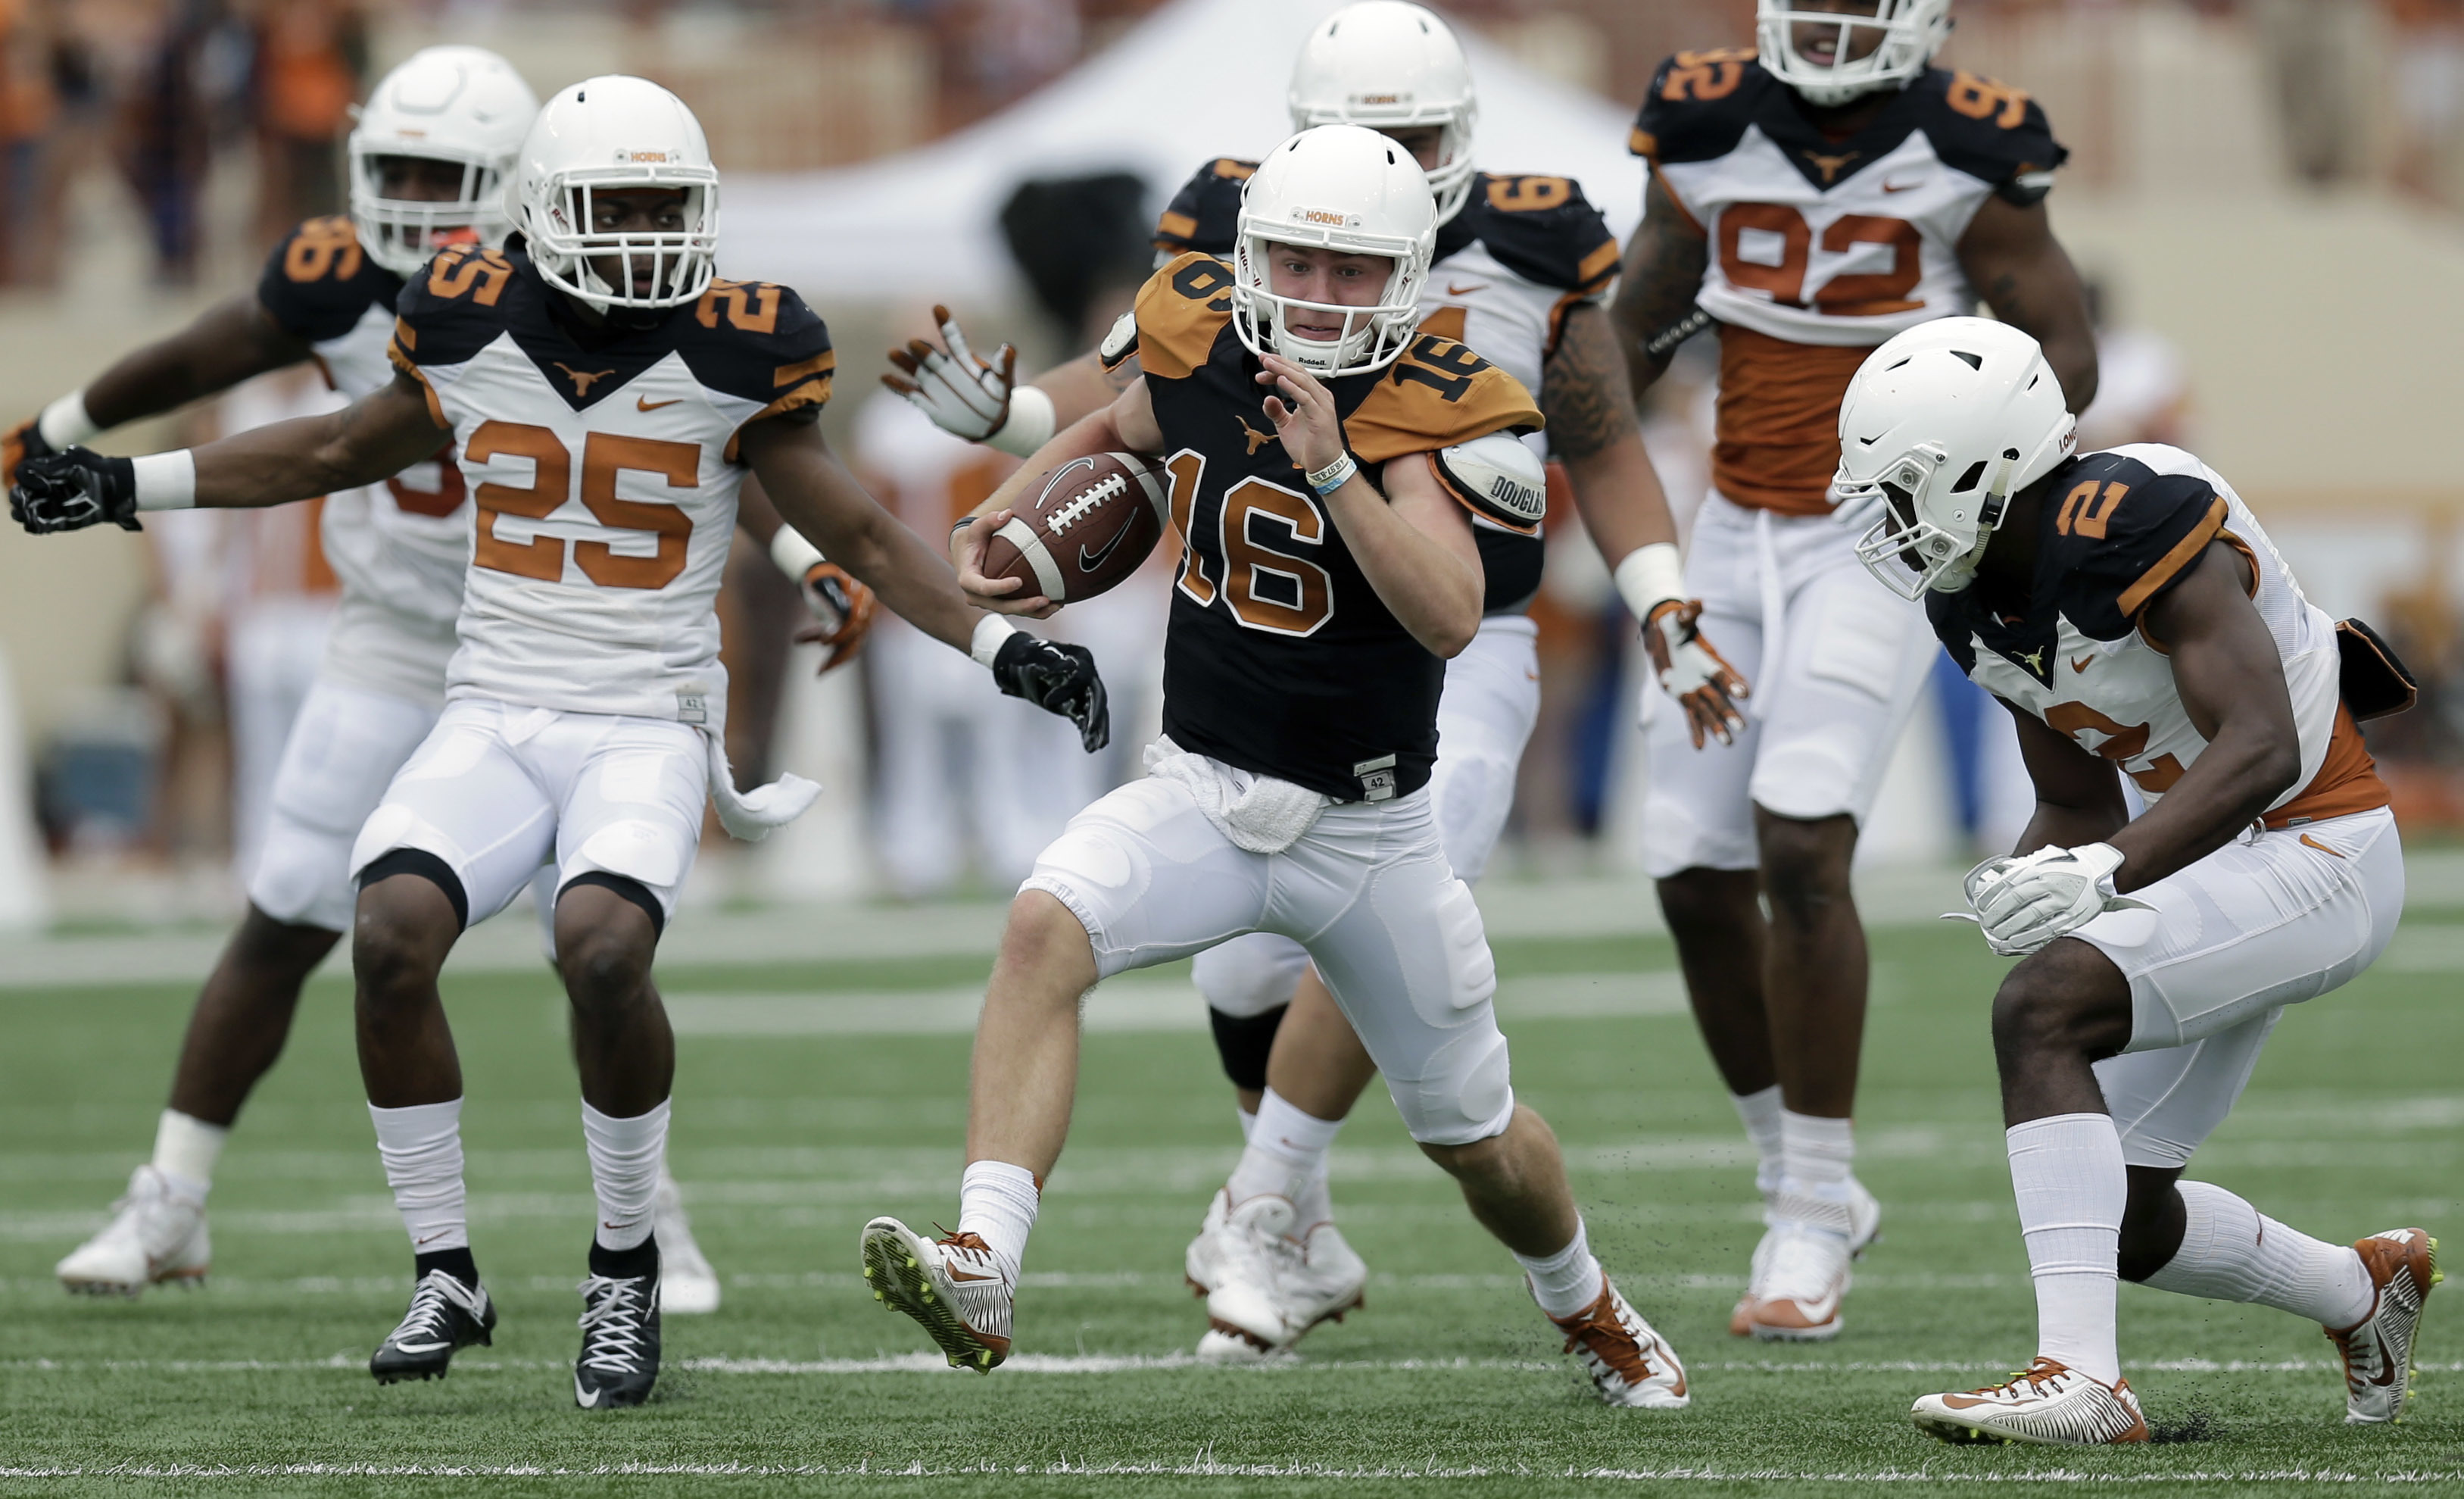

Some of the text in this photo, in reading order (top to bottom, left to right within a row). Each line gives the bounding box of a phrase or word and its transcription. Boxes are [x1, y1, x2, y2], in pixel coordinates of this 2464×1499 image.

[630, 152, 666, 163] HORNS
[1305, 211, 1343, 225] HORNS
[1718, 201, 1926, 316] 92
[464, 420, 701, 589] 25
[2056, 480, 2130, 539] 2
[1165, 448, 1333, 638] 16
[1371, 777, 1385, 788] 42
[2044, 701, 2188, 793] 2
